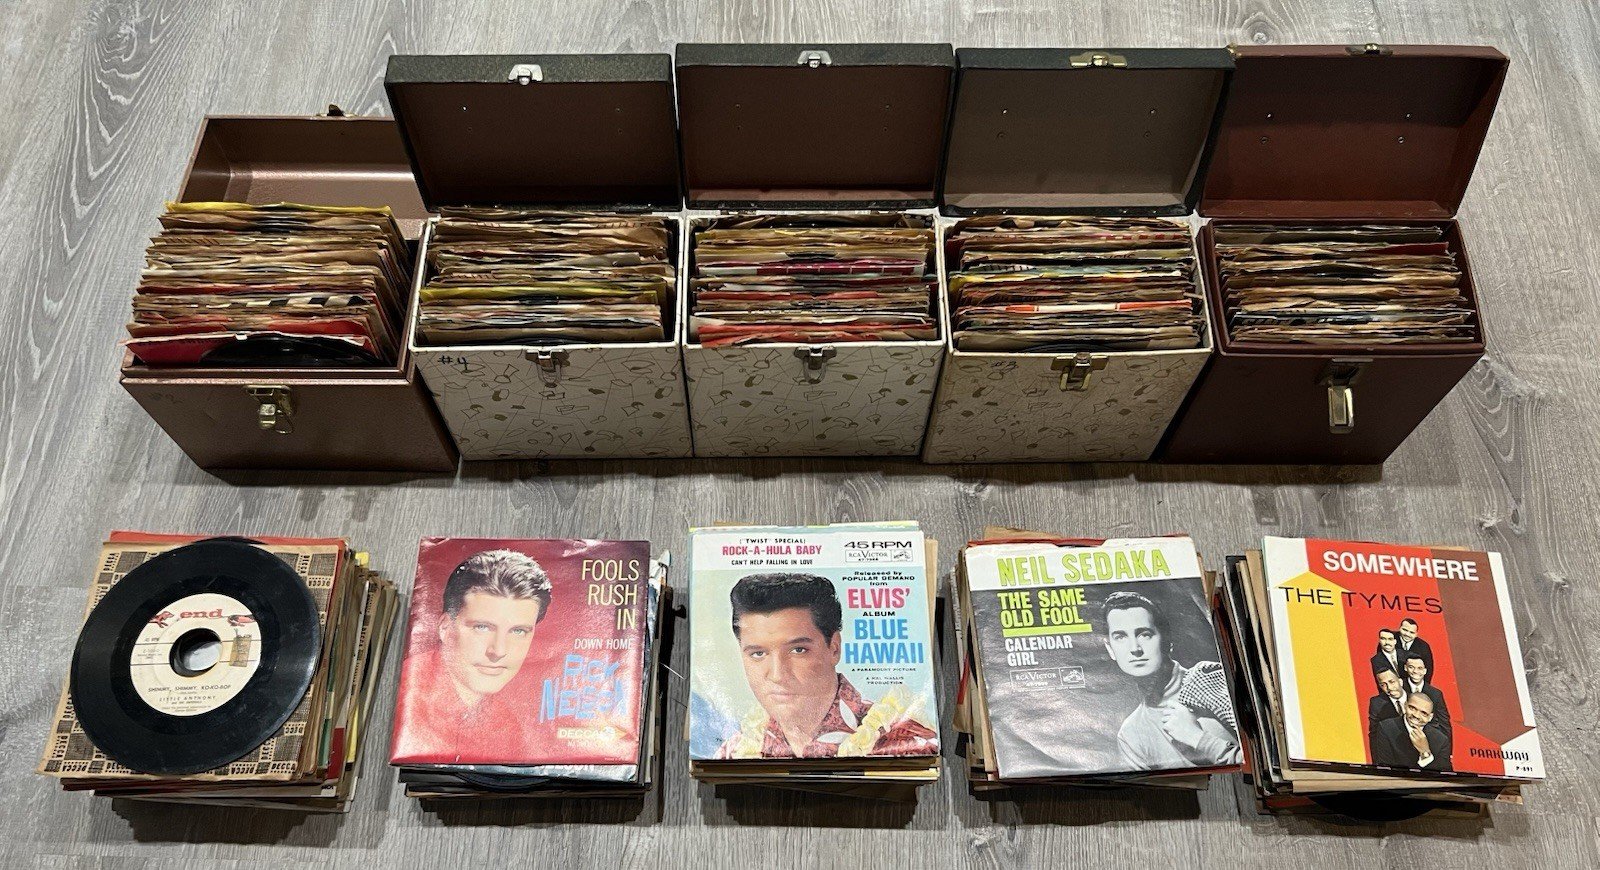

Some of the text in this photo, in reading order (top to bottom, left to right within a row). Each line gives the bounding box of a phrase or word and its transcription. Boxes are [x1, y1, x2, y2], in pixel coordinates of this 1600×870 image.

[722, 545, 822, 555] ROCK-A-HULA BABY
[582, 559, 640, 581] FOOLS
[996, 549, 1171, 587] NEIL SEDAKA
[1323, 550, 1480, 582] SOMEWHERE
[587, 584, 638, 606] RUSH
[847, 588, 910, 609] ELVIS'
[997, 588, 1087, 610] THE SAME
[1278, 586, 1443, 614] THE TYMES
[180, 609, 223, 619] end
[616, 608, 636, 630] IN
[1000, 606, 1084, 628] OLD FOOL
[854, 618, 909, 640] BLUE
[574, 638, 633, 650] DOWN HOME
[844, 642, 924, 664] HAWAII
[1004, 634, 1074, 653] CALENDAR
[1006, 651, 1039, 667] GIRL
[284, 726, 304, 734] DECC
[558, 730, 600, 739] DECCA
[1469, 748, 1529, 761] PARKWAY
[62, 764, 88, 772] DECCA
[231, 766, 256, 774] DECCA
[271, 763, 297, 771] DECCA
